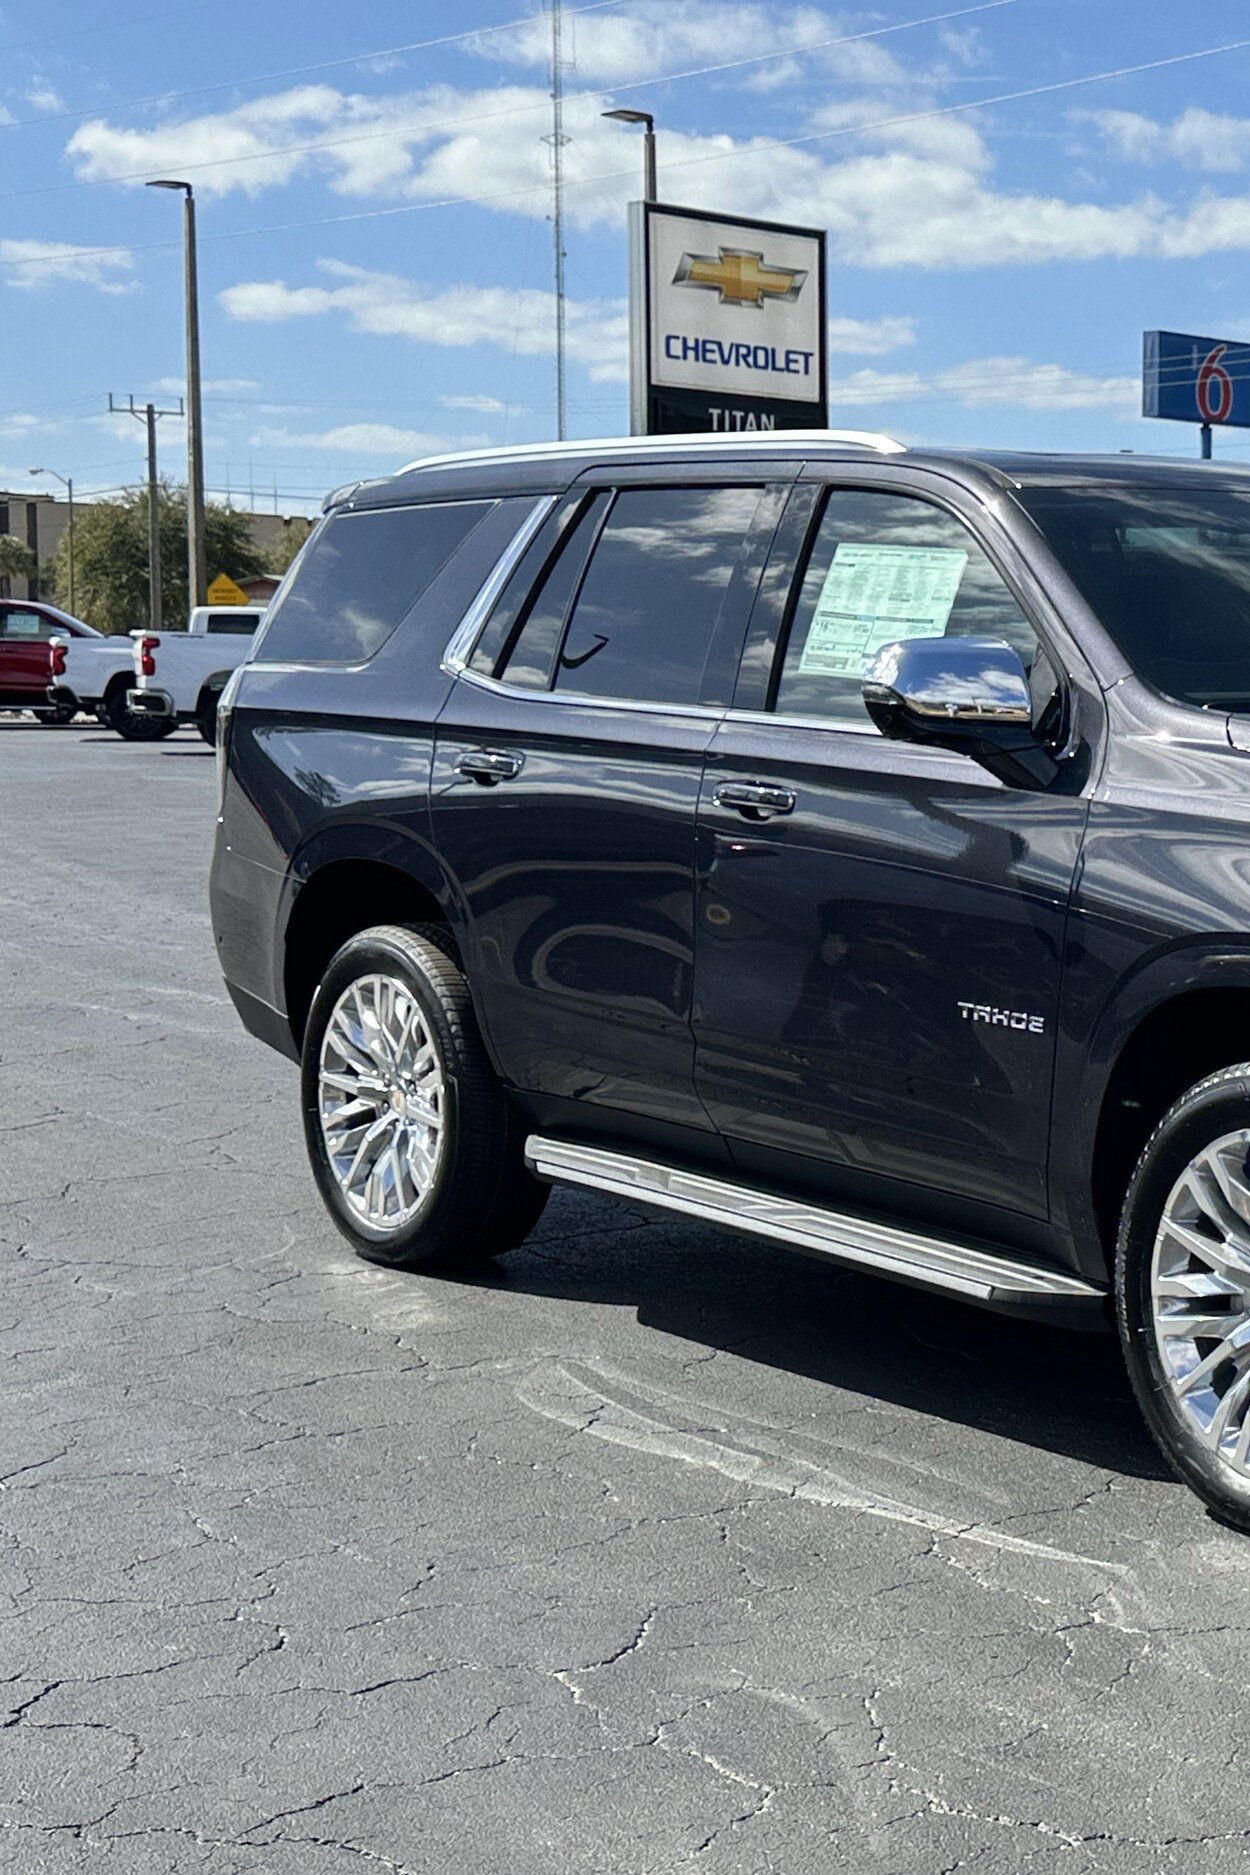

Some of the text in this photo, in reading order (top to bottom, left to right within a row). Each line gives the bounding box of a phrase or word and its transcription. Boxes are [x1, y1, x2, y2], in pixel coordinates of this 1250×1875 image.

[665, 334, 814, 375] CHEVROLET
[1195, 343, 1233, 423] 6
[708, 407, 775, 431] TITAN
[957, 1001, 1045, 1033] TAHOE
